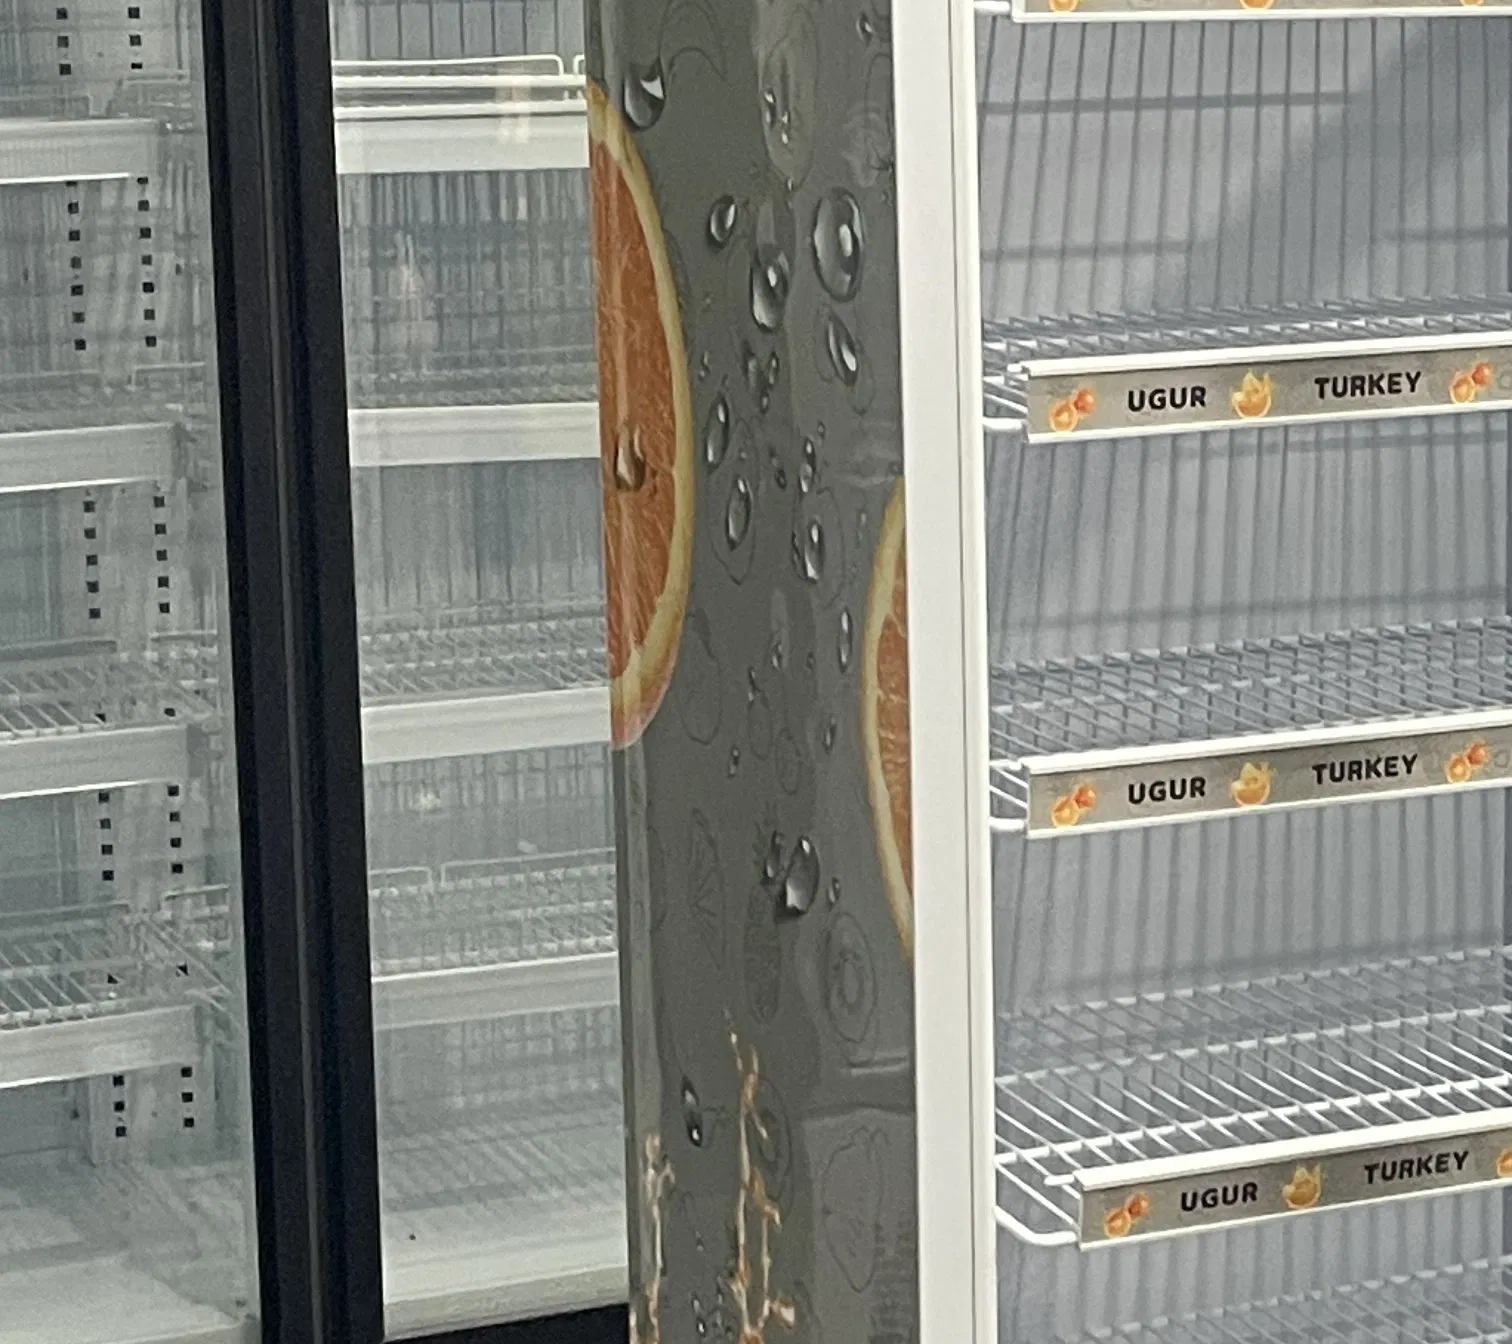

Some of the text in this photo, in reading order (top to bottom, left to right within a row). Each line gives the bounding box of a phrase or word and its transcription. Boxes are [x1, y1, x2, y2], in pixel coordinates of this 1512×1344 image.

[1127, 385, 1207, 413] UGUR
[1314, 371, 1422, 400] TURKEY
[1127, 776, 1207, 805] UGUR
[1311, 753, 1419, 786] TURKEY
[1179, 1181, 1259, 1213] UGUR
[1363, 1150, 1469, 1185] TURKEY
